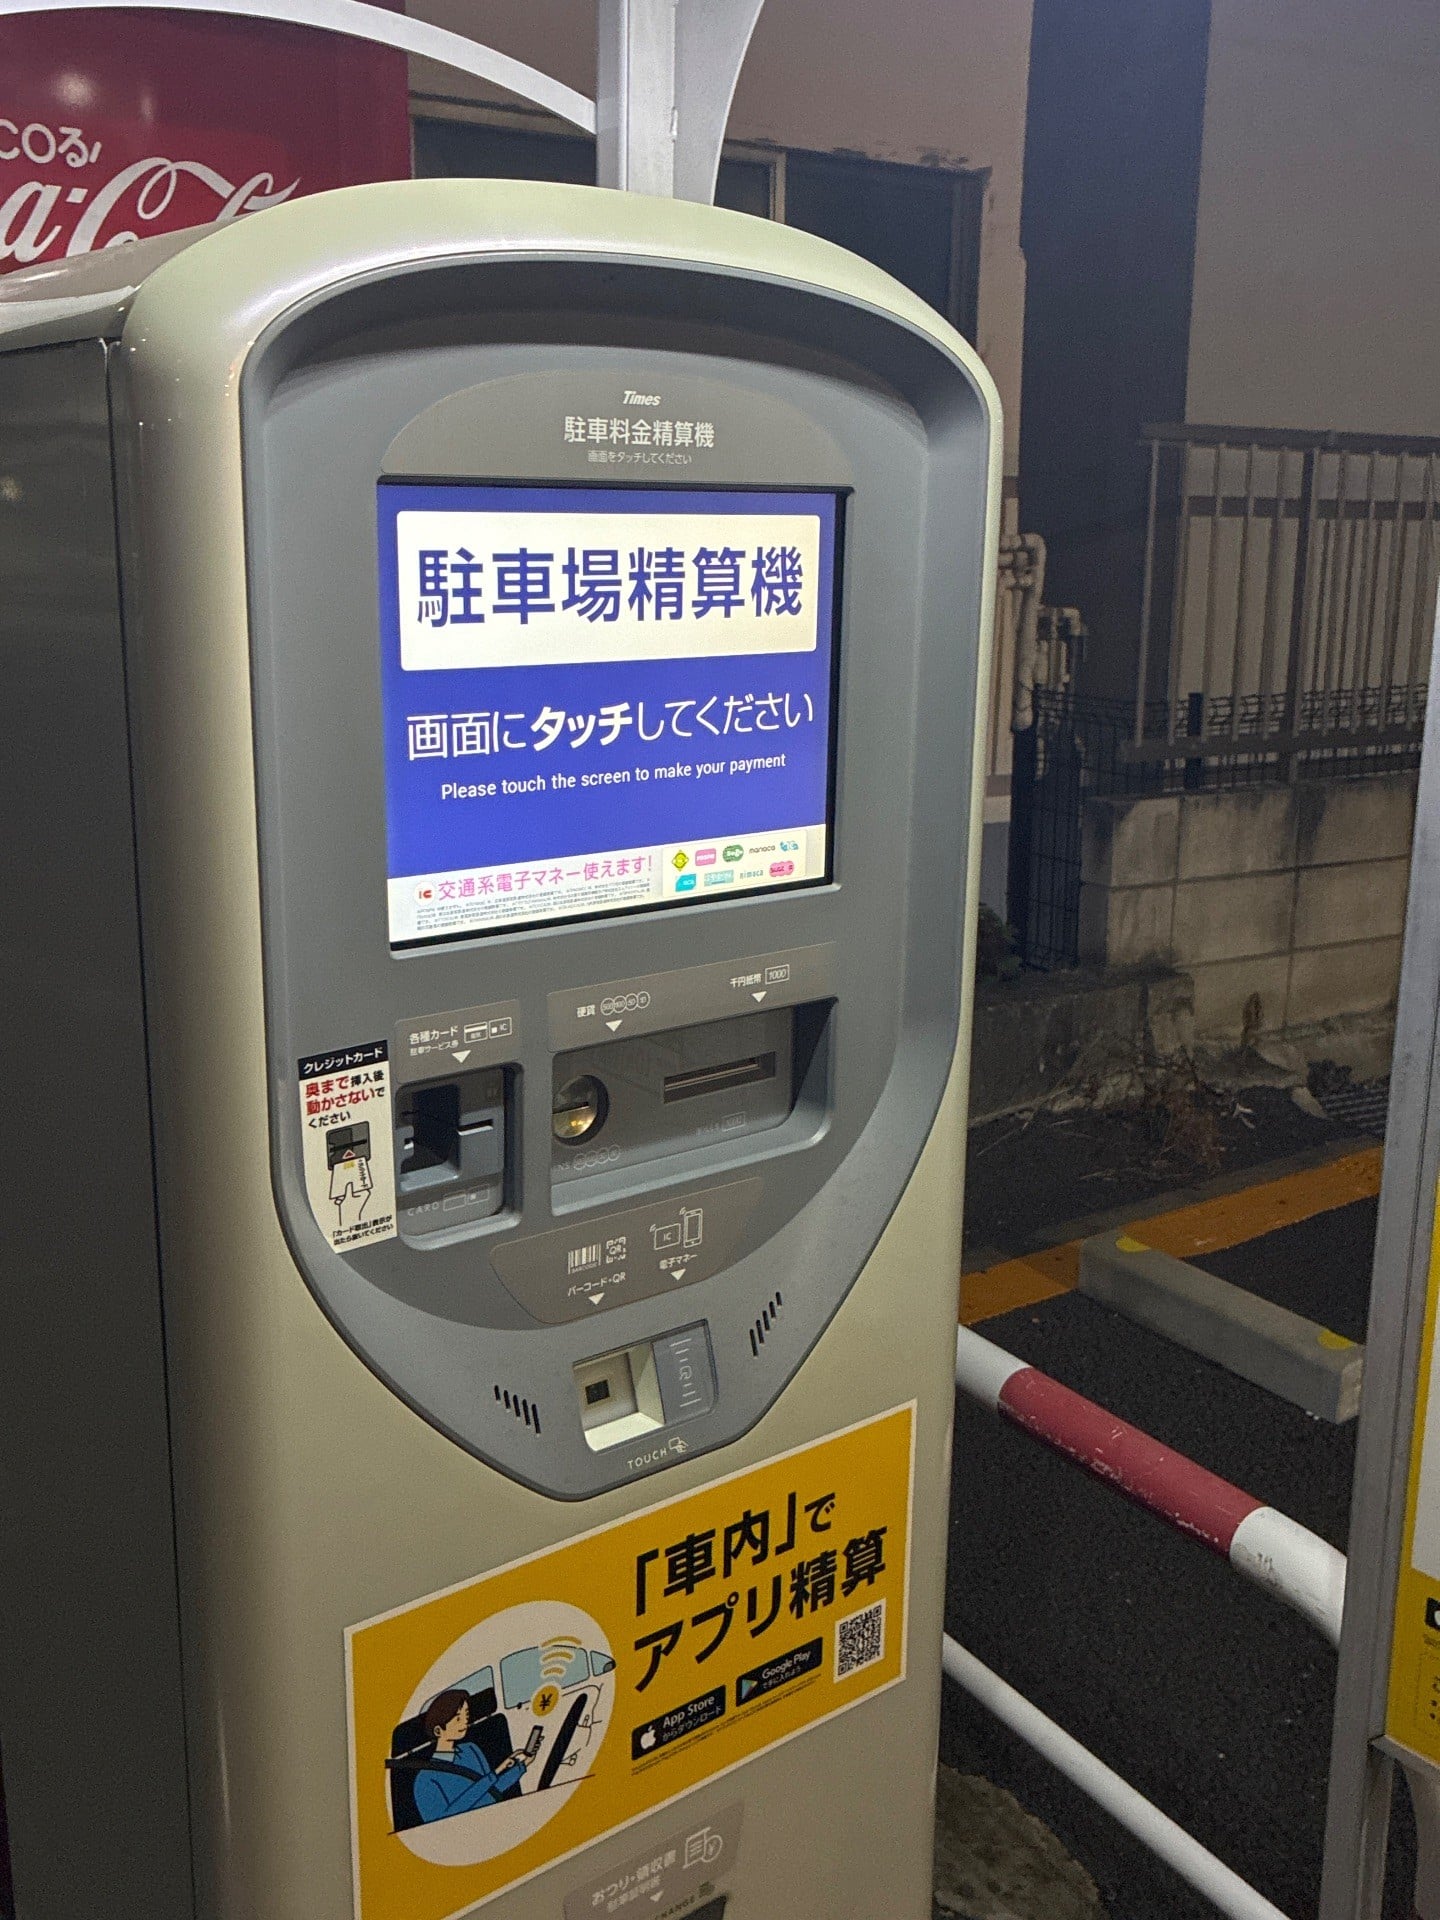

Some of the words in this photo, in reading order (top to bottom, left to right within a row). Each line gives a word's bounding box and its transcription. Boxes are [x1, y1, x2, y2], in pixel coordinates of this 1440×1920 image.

[622, 390, 661, 406] Times
[564, 416, 715, 448] 駐車料金精算機
[587, 450, 692, 465] 画面をタッチしてください
[417, 546, 804, 628] 駐車場精算機
[406, 692, 814, 760] 画面にタッチしてください
[441, 782, 497, 800] Please
[502, 775, 546, 796] touch
[551, 773, 577, 790] the
[581, 767, 631, 787] screen
[635, 766, 650, 782] to
[654, 762, 692, 780] make
[696, 760, 725, 780] your
[729, 754, 786, 775] payment
[438, 855, 652, 900] 交通系電子マネー使えます!
[769, 968, 786, 980] 1000
[303, 1047, 383, 1074] クレジットカード
[305, 1070, 384, 1098] 奥まで挿入後
[306, 1086, 385, 1116] 動かさないで
[308, 1111, 351, 1128] ください
[663, 1232, 672, 1241] IC
[627, 1447, 667, 1470] TOUCH
[636, 1491, 836, 1617] 「車内」で
[634, 1526, 888, 1692] アプリ精算
[762, 1658, 793, 1679] Google
[793, 1650, 811, 1664] Play
[663, 1711, 685, 1729] App
[688, 1696, 715, 1716] Store
[663, 1705, 721, 1742] からダウンロード
